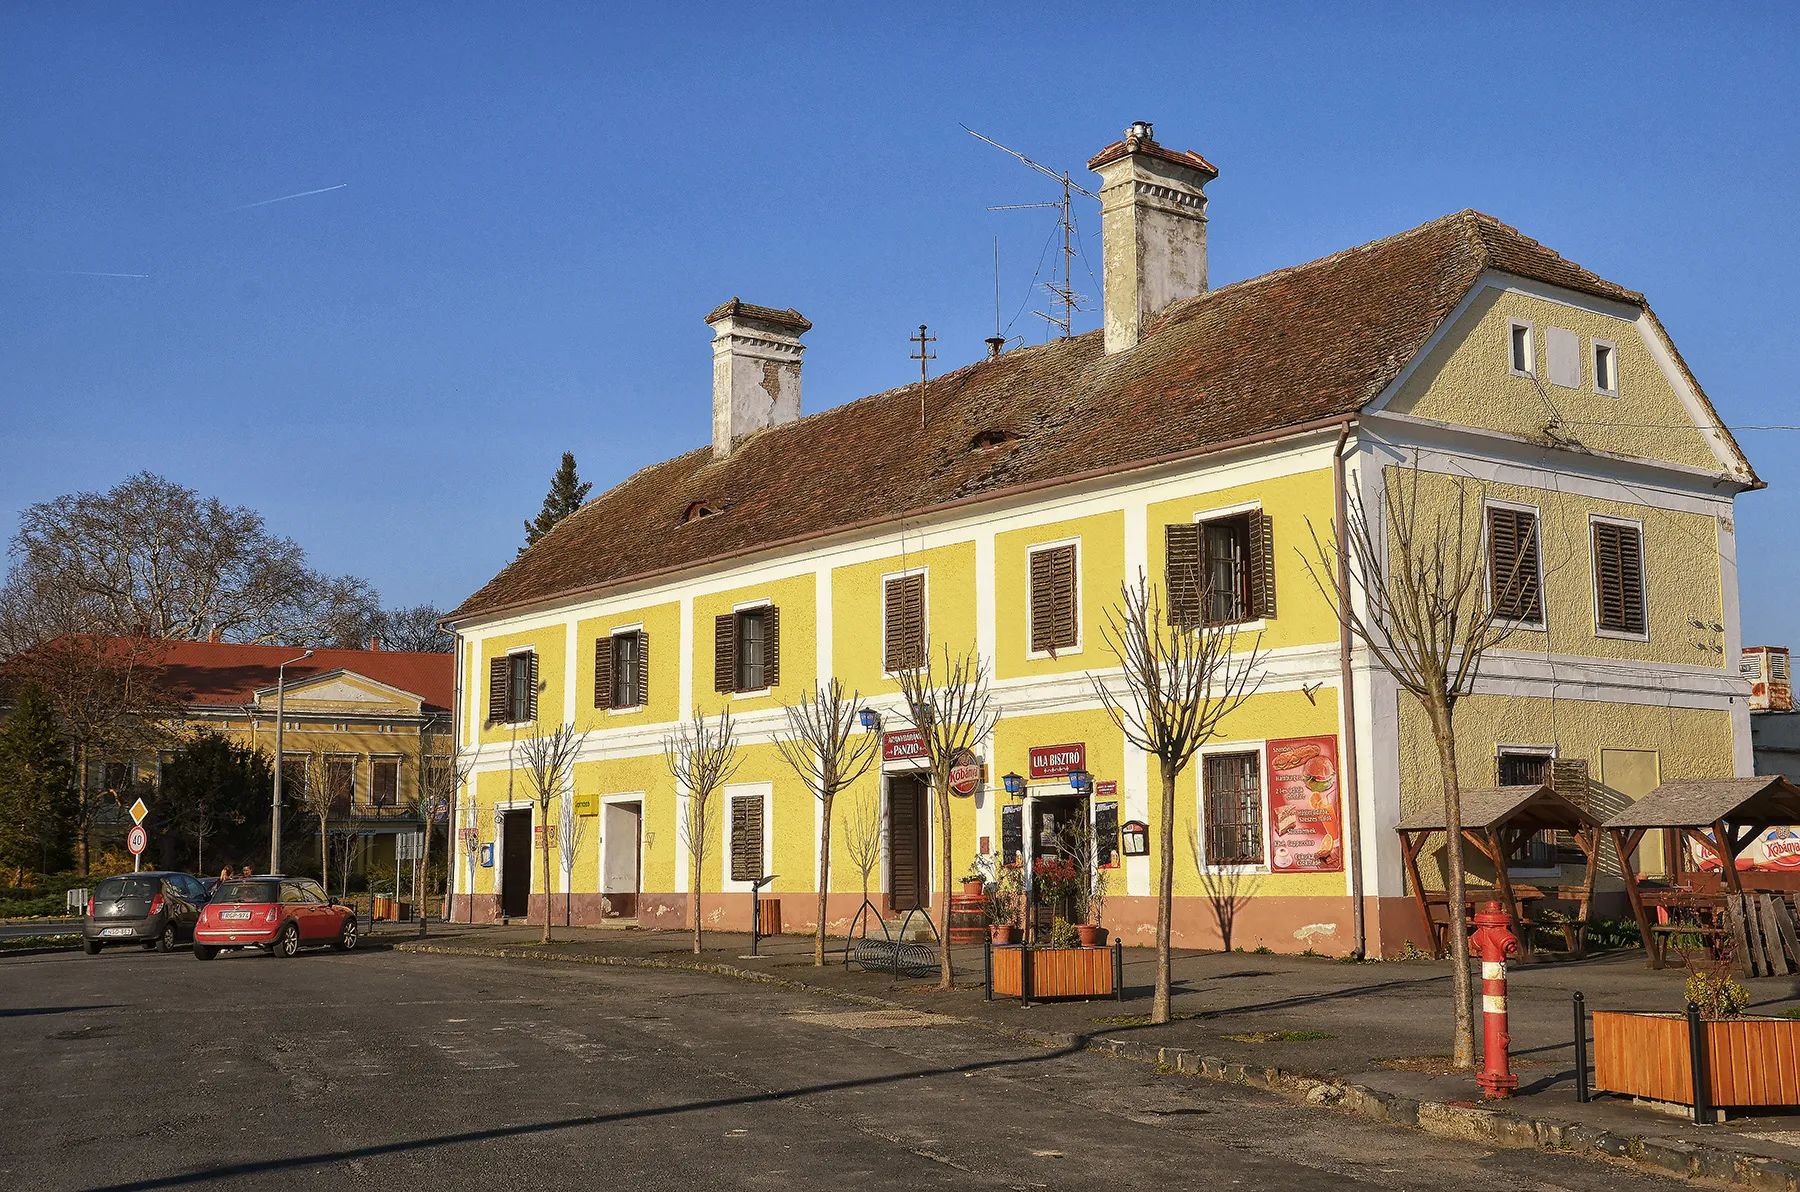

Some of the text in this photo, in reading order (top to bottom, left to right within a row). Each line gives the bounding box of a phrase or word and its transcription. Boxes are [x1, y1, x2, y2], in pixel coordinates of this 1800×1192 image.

[893, 740, 919, 756] PANZIÓ
[1033, 748, 1080, 768] LILA BISZTRÓ
[132, 835, 142, 846] 40
[1766, 840, 1800, 858] Kőbánya
